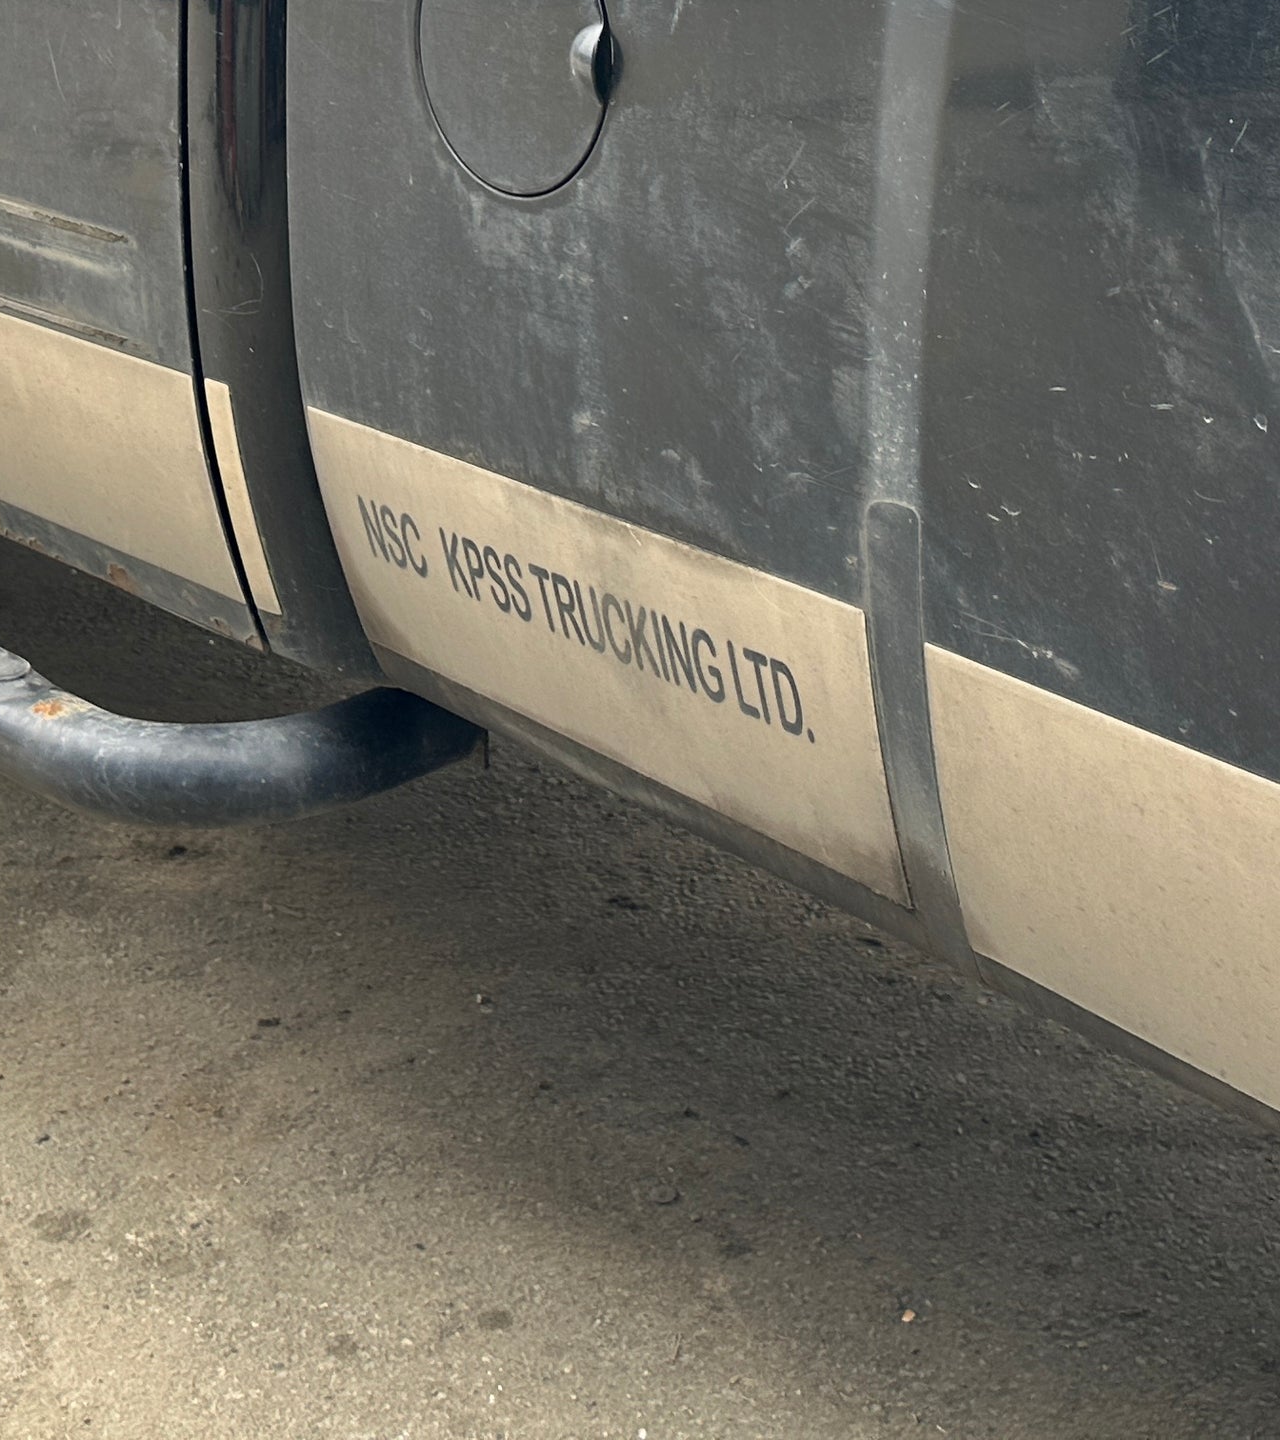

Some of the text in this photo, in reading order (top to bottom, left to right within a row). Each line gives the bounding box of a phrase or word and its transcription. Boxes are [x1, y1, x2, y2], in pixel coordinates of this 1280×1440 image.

[357, 494, 816, 744] NSC KPSS TRUCKING LTD.
